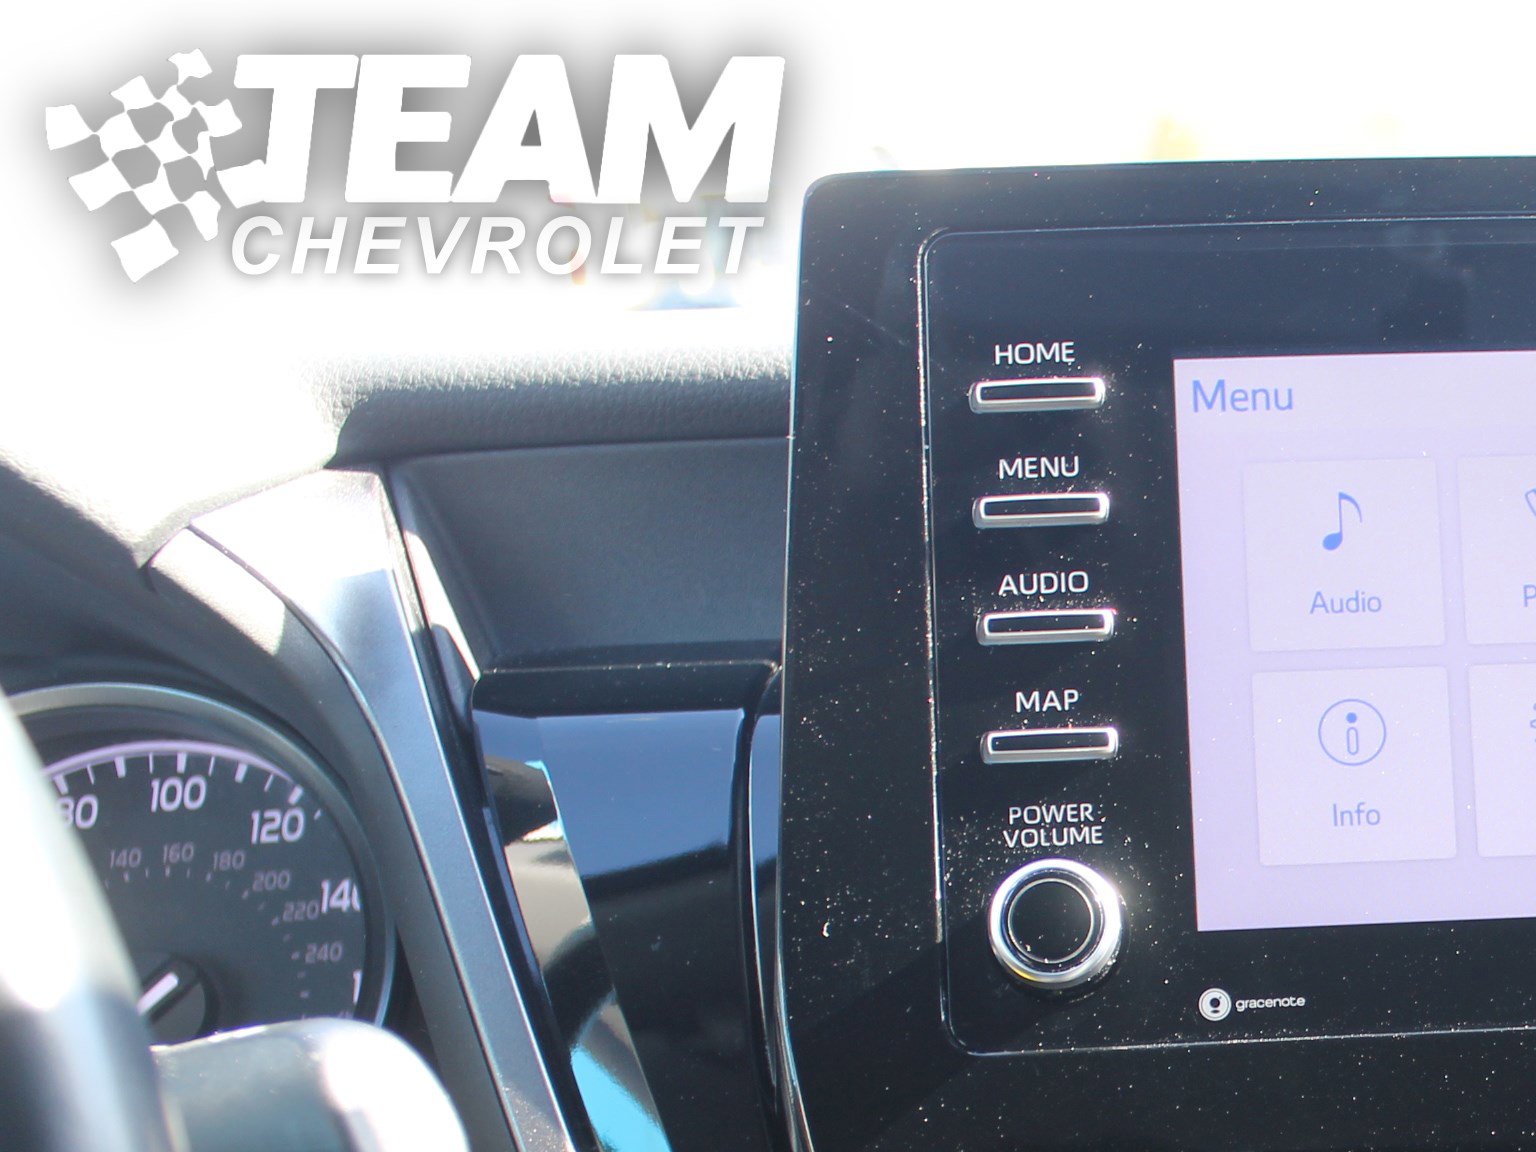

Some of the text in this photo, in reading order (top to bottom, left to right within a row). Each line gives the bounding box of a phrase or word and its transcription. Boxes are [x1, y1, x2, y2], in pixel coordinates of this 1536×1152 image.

[995, 342, 1075, 365] HOME
[1192, 379, 1293, 412] Menu
[999, 456, 1079, 479] MENU
[999, 571, 1089, 595] AUDIO
[1310, 591, 1382, 614] Audio
[1015, 689, 1079, 712] MAP
[151, 776, 206, 812] 100
[1009, 803, 1093, 825] POWER
[1332, 803, 1380, 826] Info
[251, 809, 304, 843] 120
[1003, 825, 1103, 848] VOLUME
[110, 849, 141, 868] 140
[163, 843, 194, 862] 160
[213, 851, 245, 871] 180
[252, 871, 290, 890] 200
[282, 902, 319, 921] 220
[305, 942, 343, 963] 240
[1235, 996, 1306, 1011] gracenote
